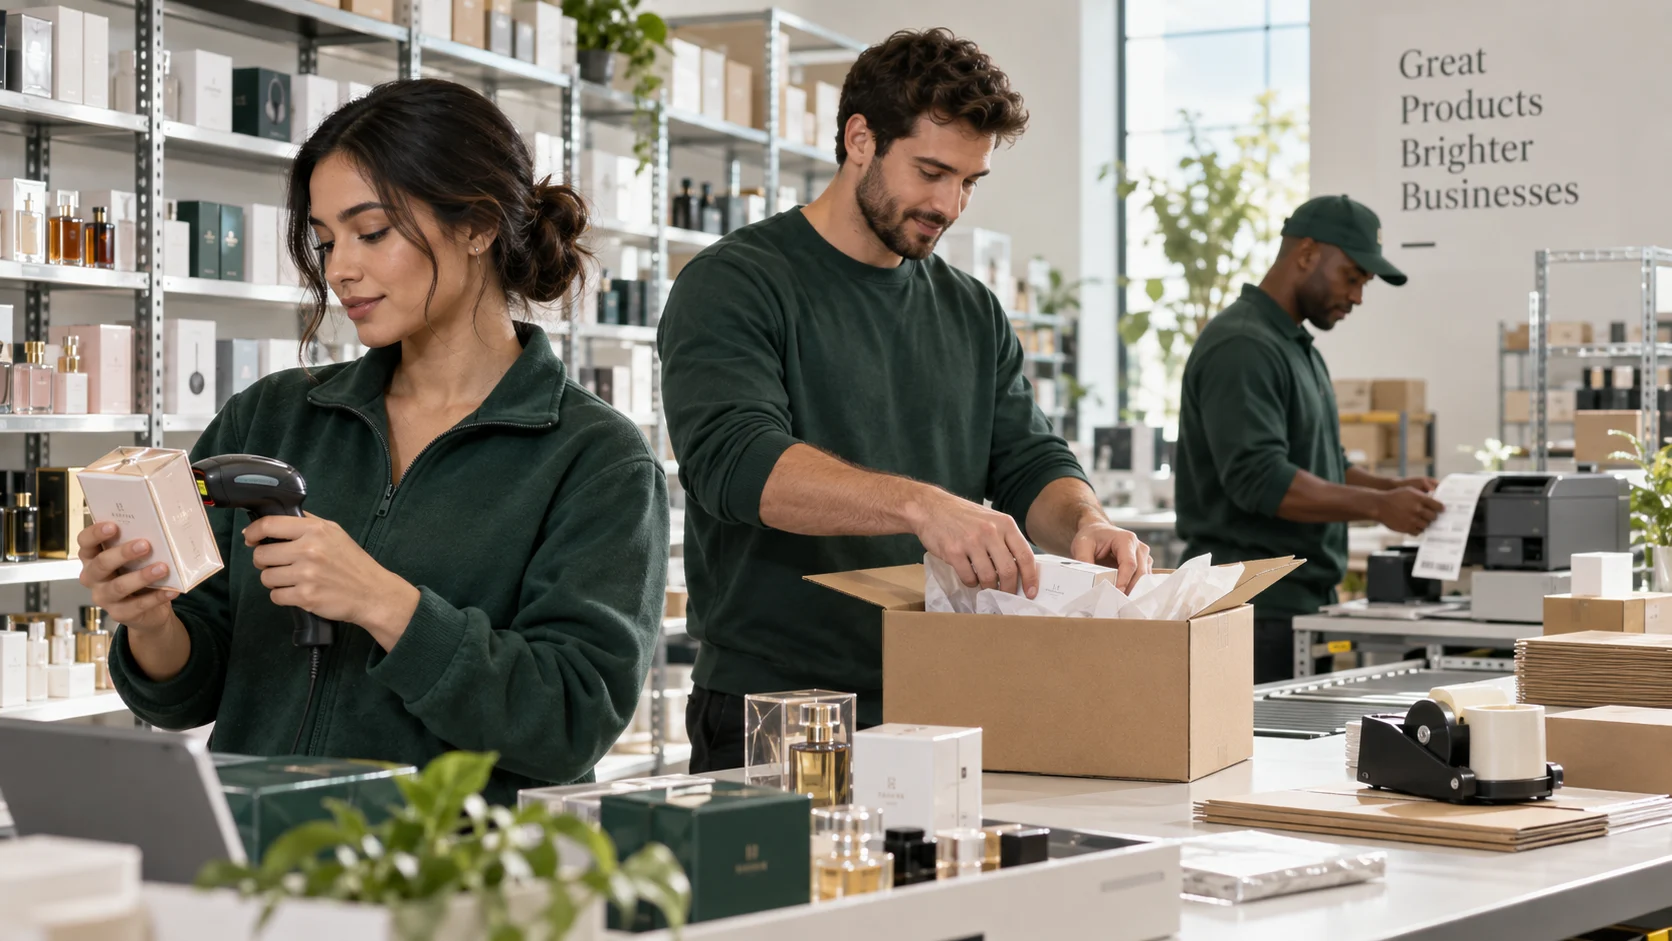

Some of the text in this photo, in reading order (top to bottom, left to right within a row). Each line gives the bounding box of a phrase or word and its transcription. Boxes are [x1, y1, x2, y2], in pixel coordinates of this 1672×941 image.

[1399, 48, 1487, 79] Great
[1401, 88, 1543, 124] Products
[1401, 133, 1534, 174] Brighter
[1401, 178, 1579, 211] Businesses
